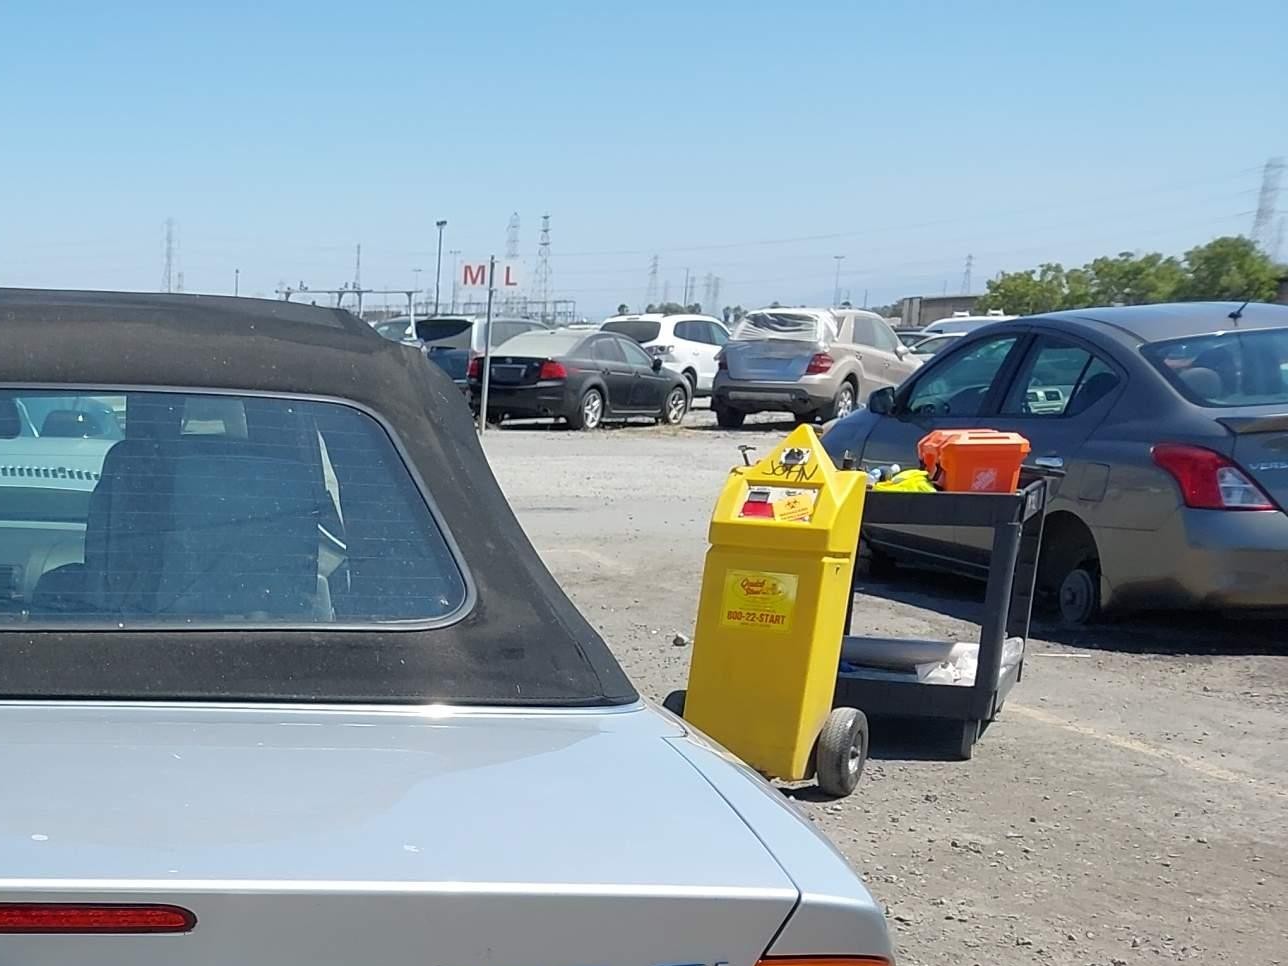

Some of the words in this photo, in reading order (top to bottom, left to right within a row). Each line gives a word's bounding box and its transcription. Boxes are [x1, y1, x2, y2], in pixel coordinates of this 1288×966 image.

[463, 264, 486, 285] M
[504, 265, 518, 286] L
[761, 460, 819, 482] JOHN
